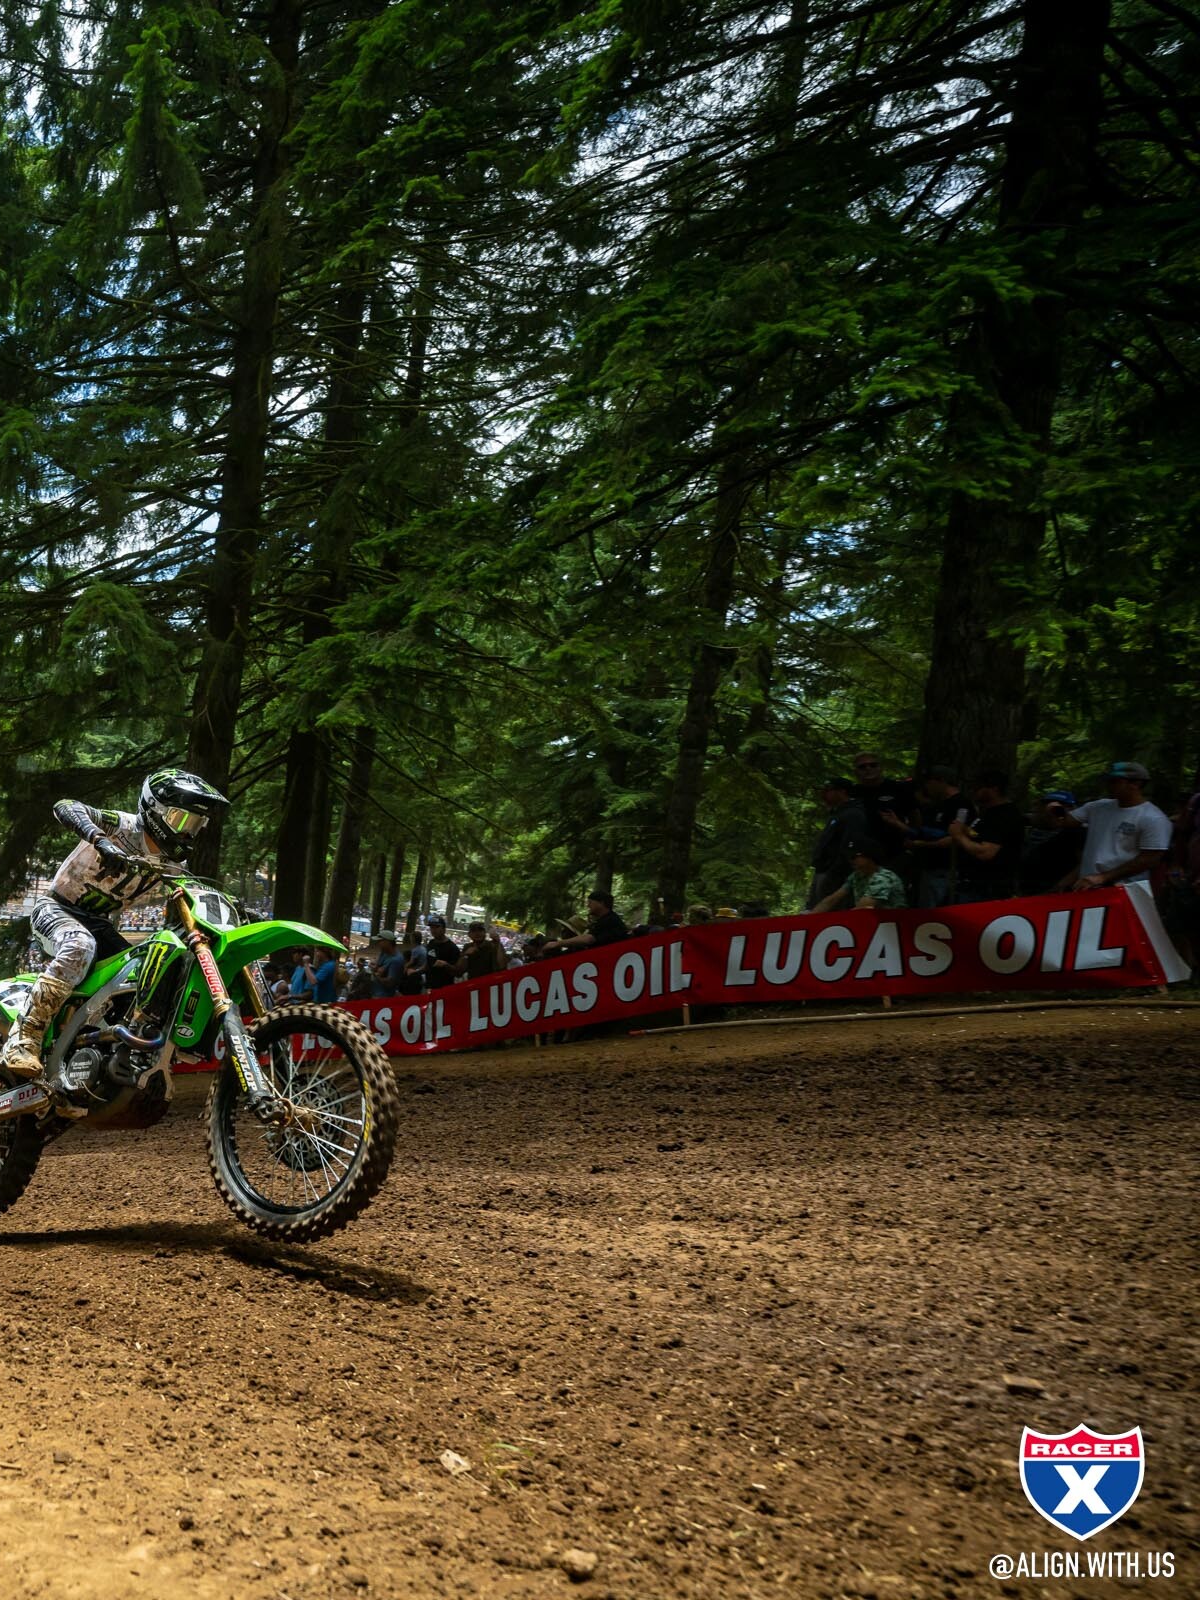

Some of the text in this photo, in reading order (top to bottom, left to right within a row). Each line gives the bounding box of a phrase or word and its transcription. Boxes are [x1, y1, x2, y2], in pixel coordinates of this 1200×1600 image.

[197, 953, 224, 995] SHOWA
[724, 906, 1125, 986] LUCAS OIL
[469, 962, 598, 1032] LUCAS
[613, 941, 692, 1002] OIL
[400, 998, 451, 1044] OIL
[230, 1034, 258, 1091] DUNLOP
